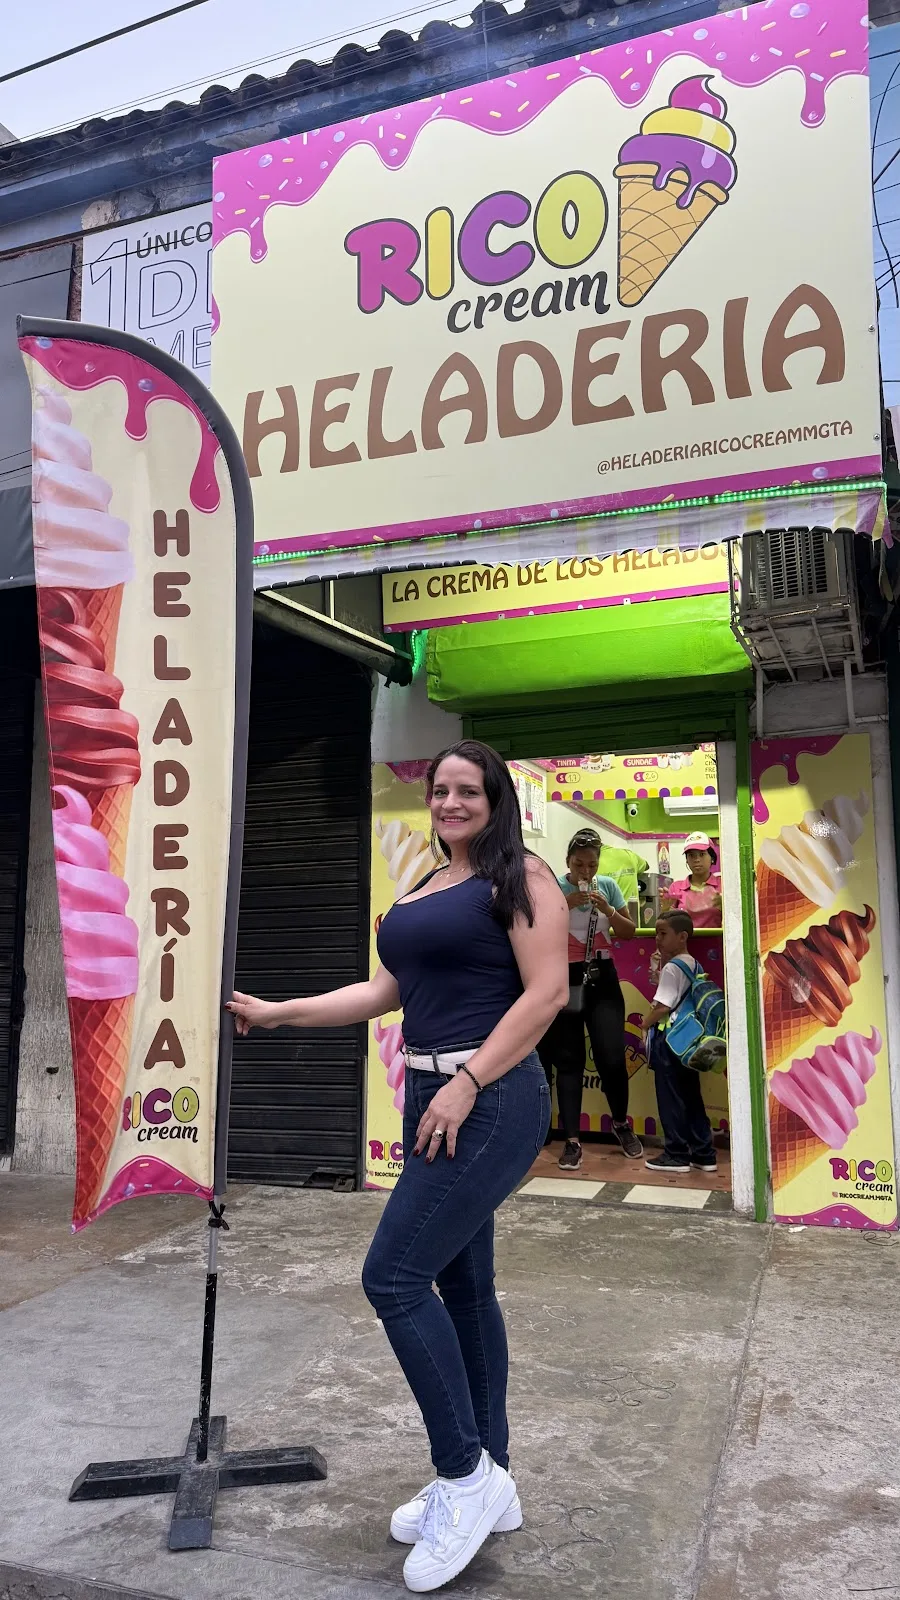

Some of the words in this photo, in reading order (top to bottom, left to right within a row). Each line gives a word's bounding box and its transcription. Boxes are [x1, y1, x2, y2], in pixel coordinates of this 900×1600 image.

[136, 221, 213, 259] ÚNICO
[344, 170, 609, 315] RICO
[446, 270, 611, 333] cream
[243, 284, 846, 478] HELADERIA
[597, 420, 853, 475] @HELADERIARICOCREAMMGTA
[392, 579, 419, 602] LA
[426, 567, 509, 598] CREMA
[517, 560, 547, 587] DE
[556, 555, 604, 580] LOS
[612, 545, 727, 574] HELADO
[626, 758, 653, 766] SUNDAE
[144, 508, 193, 1070] HELADERÍA
[137, 1125, 199, 1143] cream
[368, 1140, 404, 1162] RIC
[829, 1157, 893, 1182] RICO
[855, 1182, 894, 1195] cream
